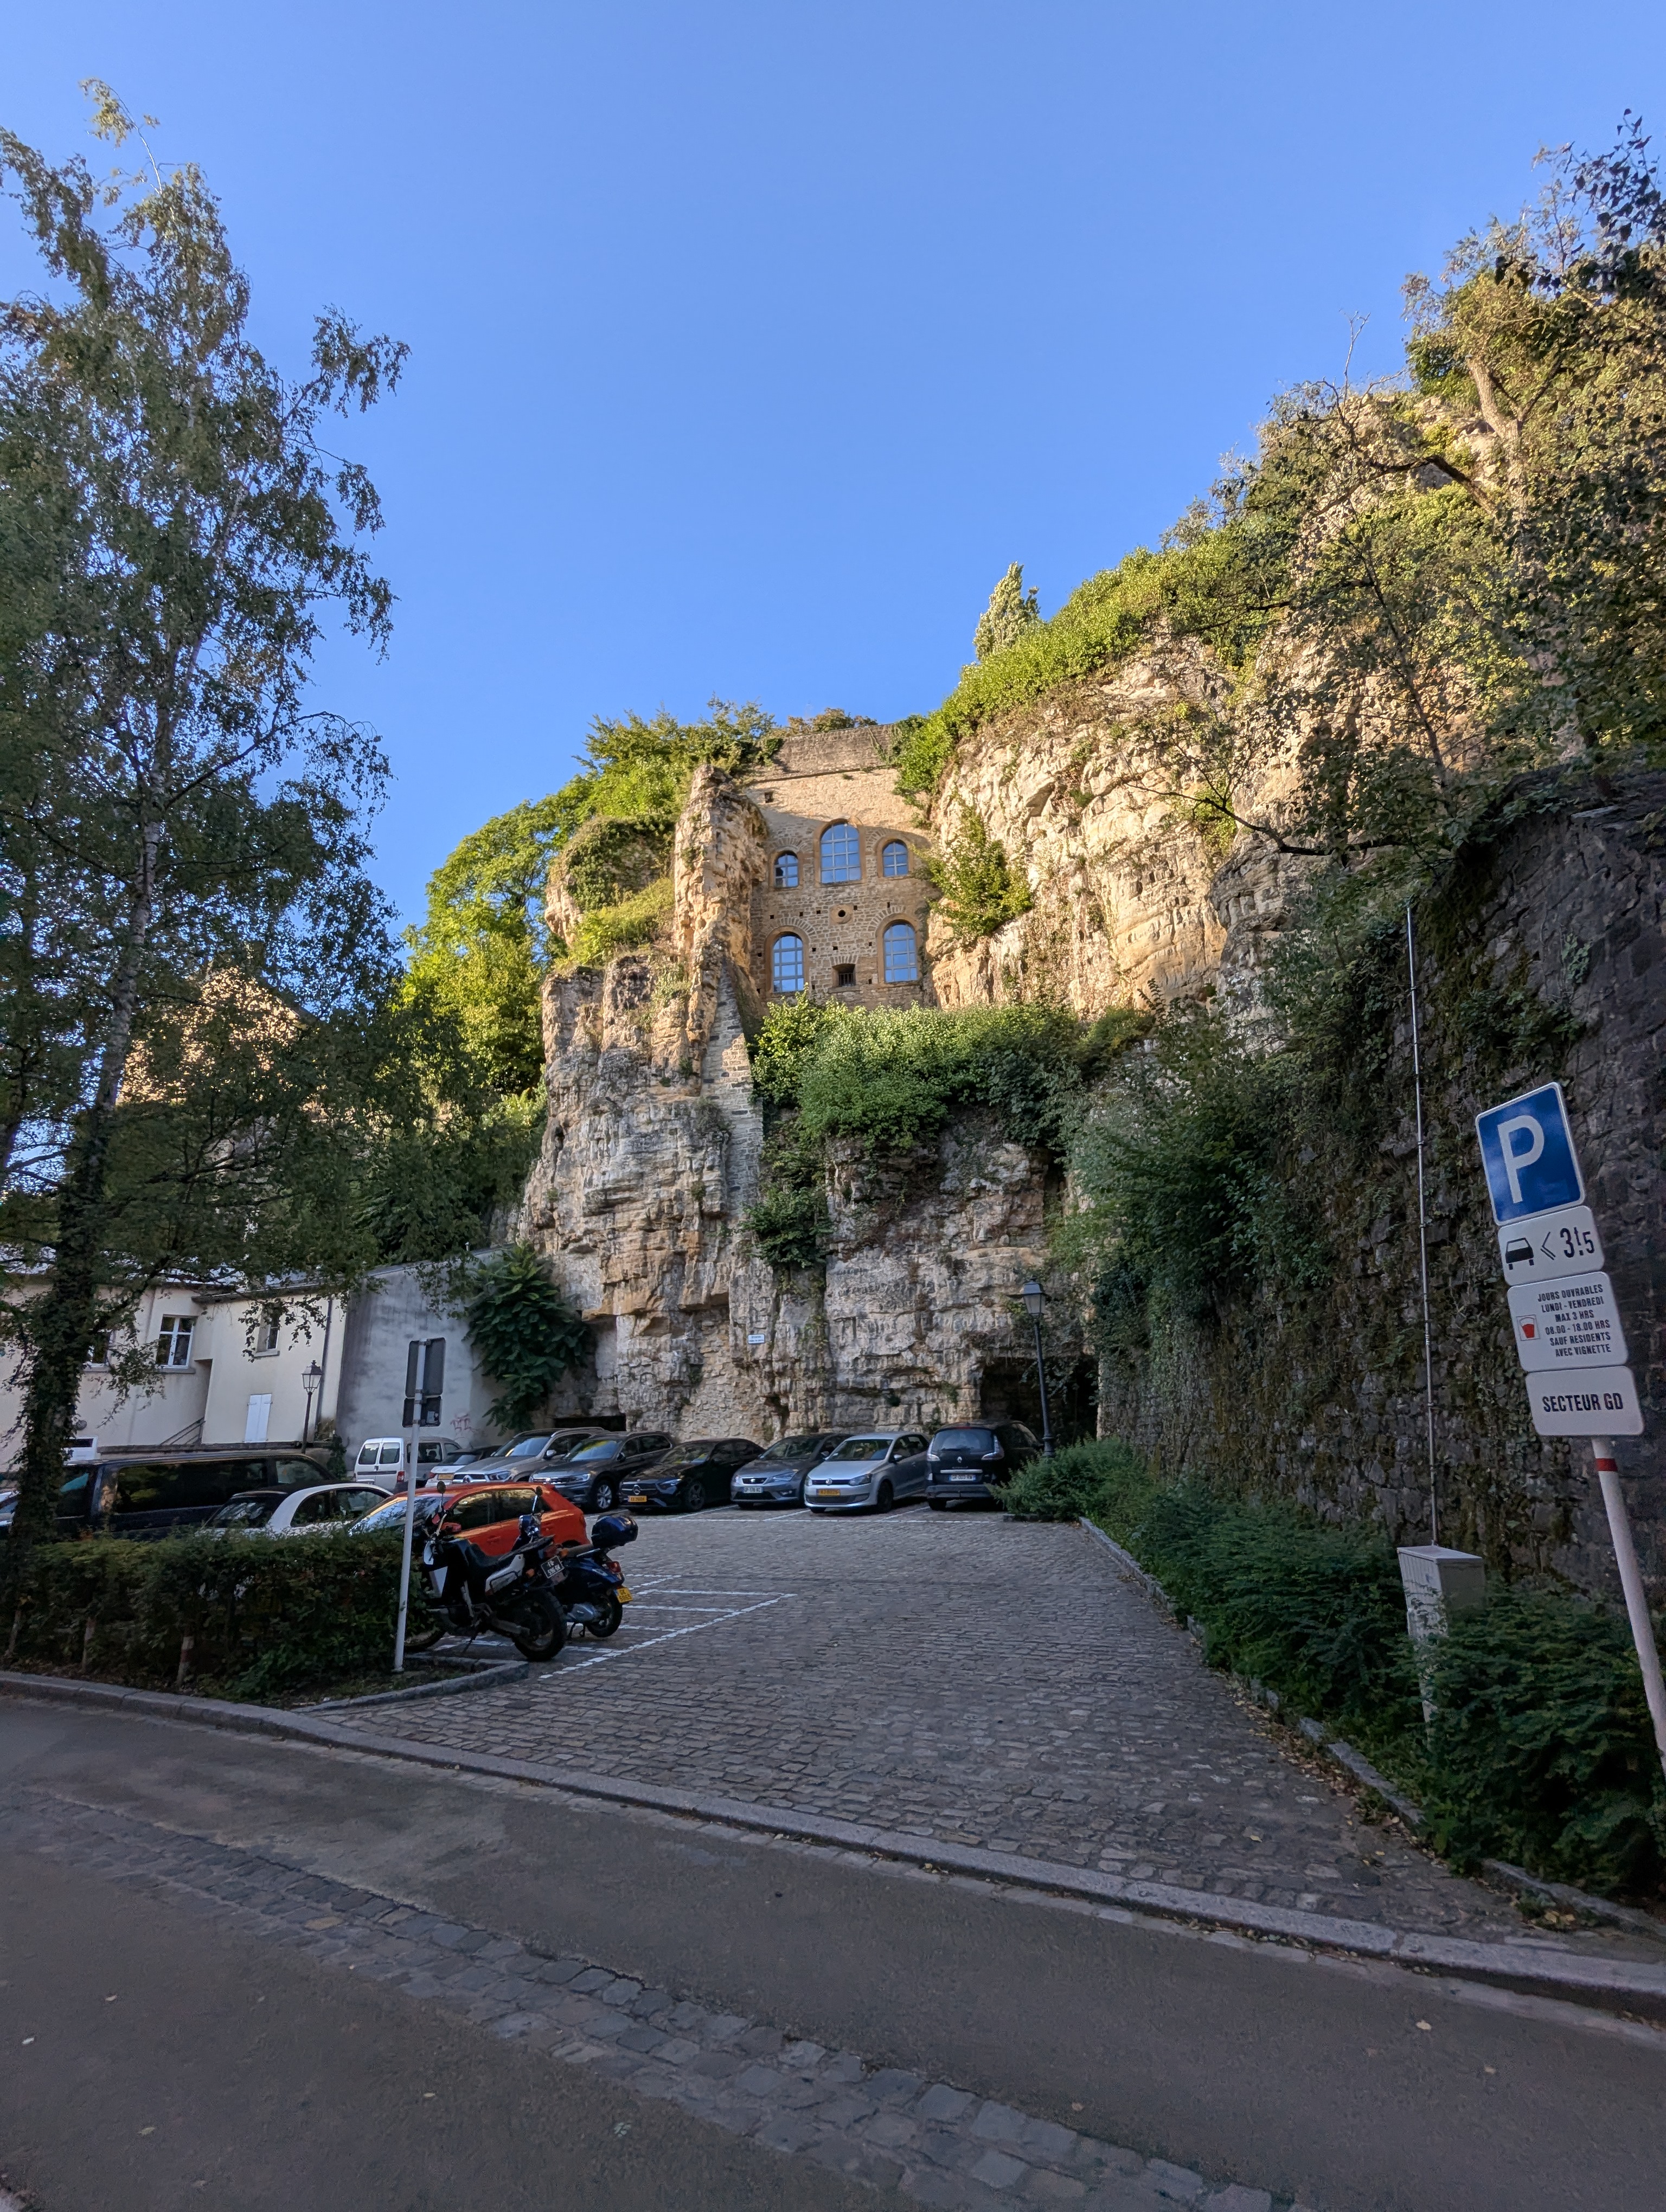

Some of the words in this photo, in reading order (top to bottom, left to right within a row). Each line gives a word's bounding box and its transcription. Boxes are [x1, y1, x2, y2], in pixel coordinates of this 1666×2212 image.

[1497, 1115, 1545, 1204] P
[1537, 1291, 1560, 1302] JOURS
[1561, 1284, 1604, 1298] OUVRABLES
[1541, 1302, 1562, 1313] LUNDI
[1568, 1296, 1604, 1309] VENDREDI
[1555, 1313, 1571, 1322] MAX
[1572, 1311, 1578, 1320] 3
[1579, 1309, 1594, 1320] HRS
[1545, 1324, 1566, 1335] 08.00
[1572, 1321, 1593, 1332] 18.00
[1595, 1319, 1611, 1329] HRS
[1550, 1336, 1568, 1346] SAUF
[1570, 1332, 1611, 1344] RESIDENTS
[1555, 1347, 1573, 1357] AVEC
[1574, 1344, 1611, 1355] VIGNETTE
[1542, 1394, 1601, 1412] SECTEUR
[1603, 1392, 1623, 1410] GD
